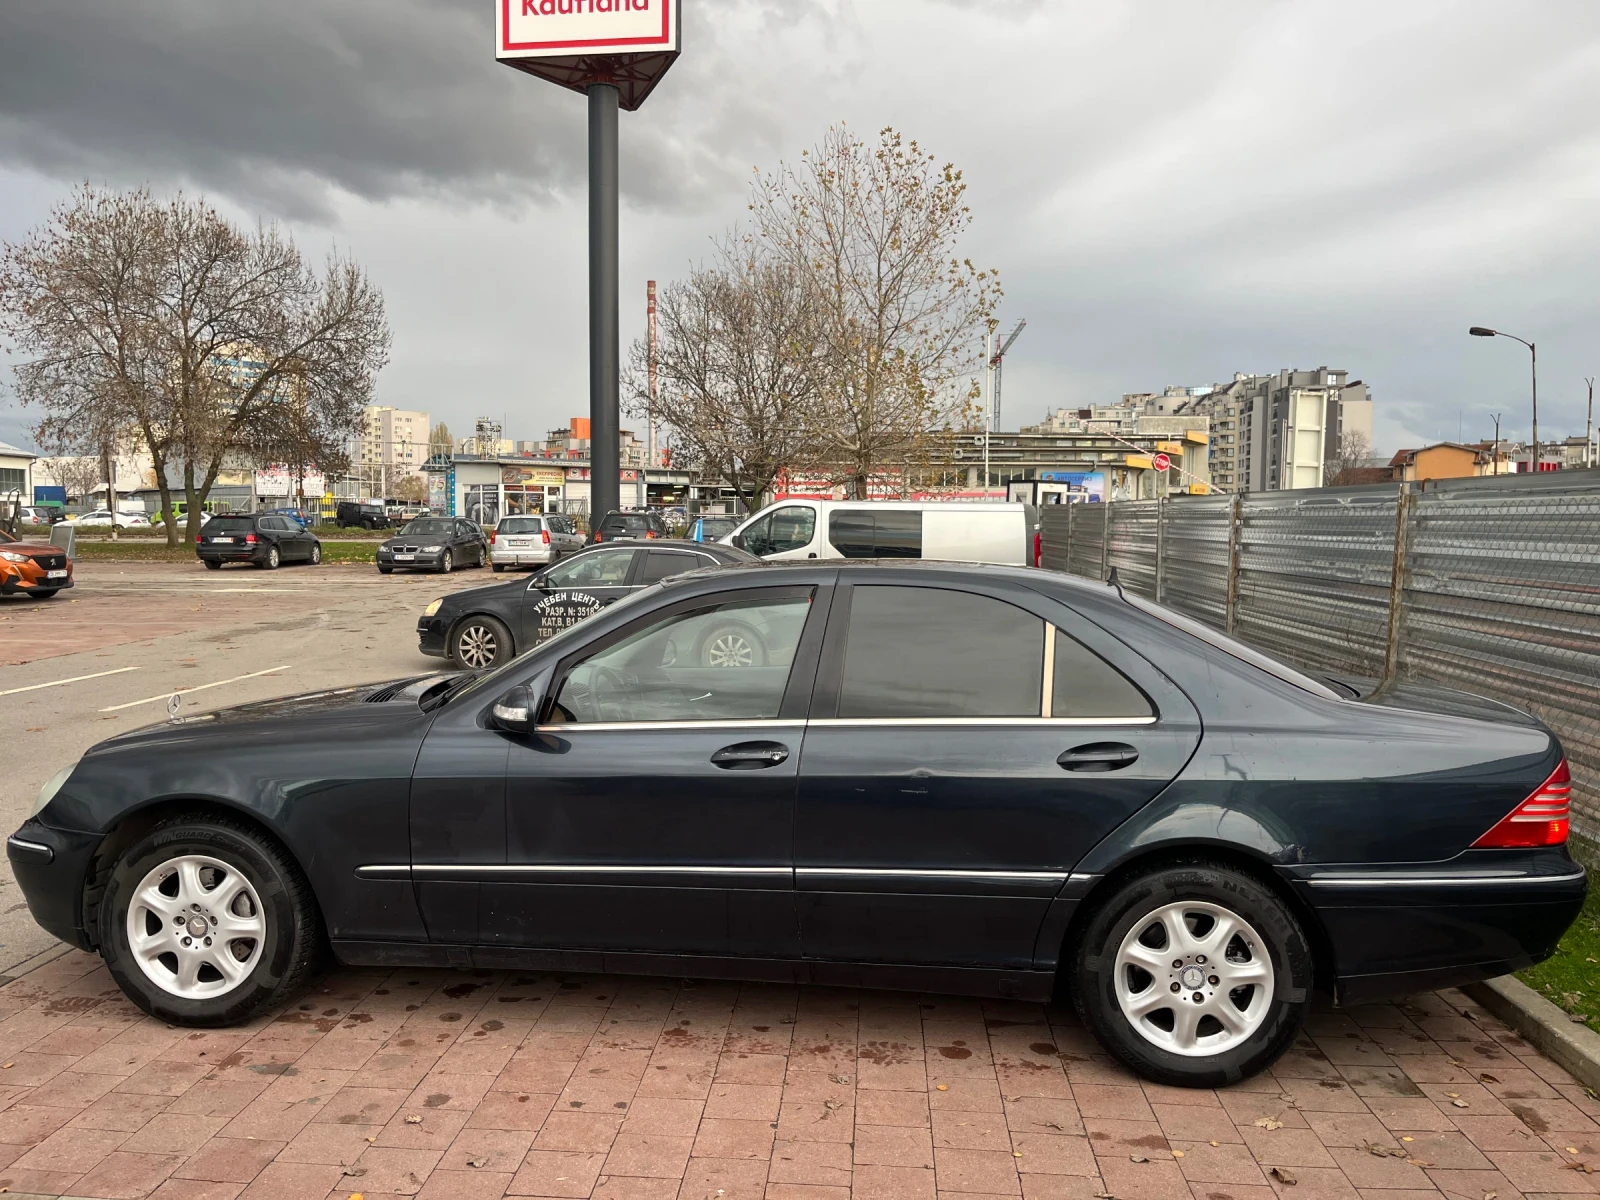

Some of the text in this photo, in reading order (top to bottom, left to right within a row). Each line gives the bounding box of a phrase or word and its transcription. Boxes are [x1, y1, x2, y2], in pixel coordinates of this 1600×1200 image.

[522, 0, 649, 16] Kaufland
[1155, 457, 1169, 467] STOP
[533, 592, 605, 614] УЧЕБЕН ЦЕНТЪ
[545, 606, 566, 617] РАЗР.
[1222, 879, 1288, 933] NEXEN
